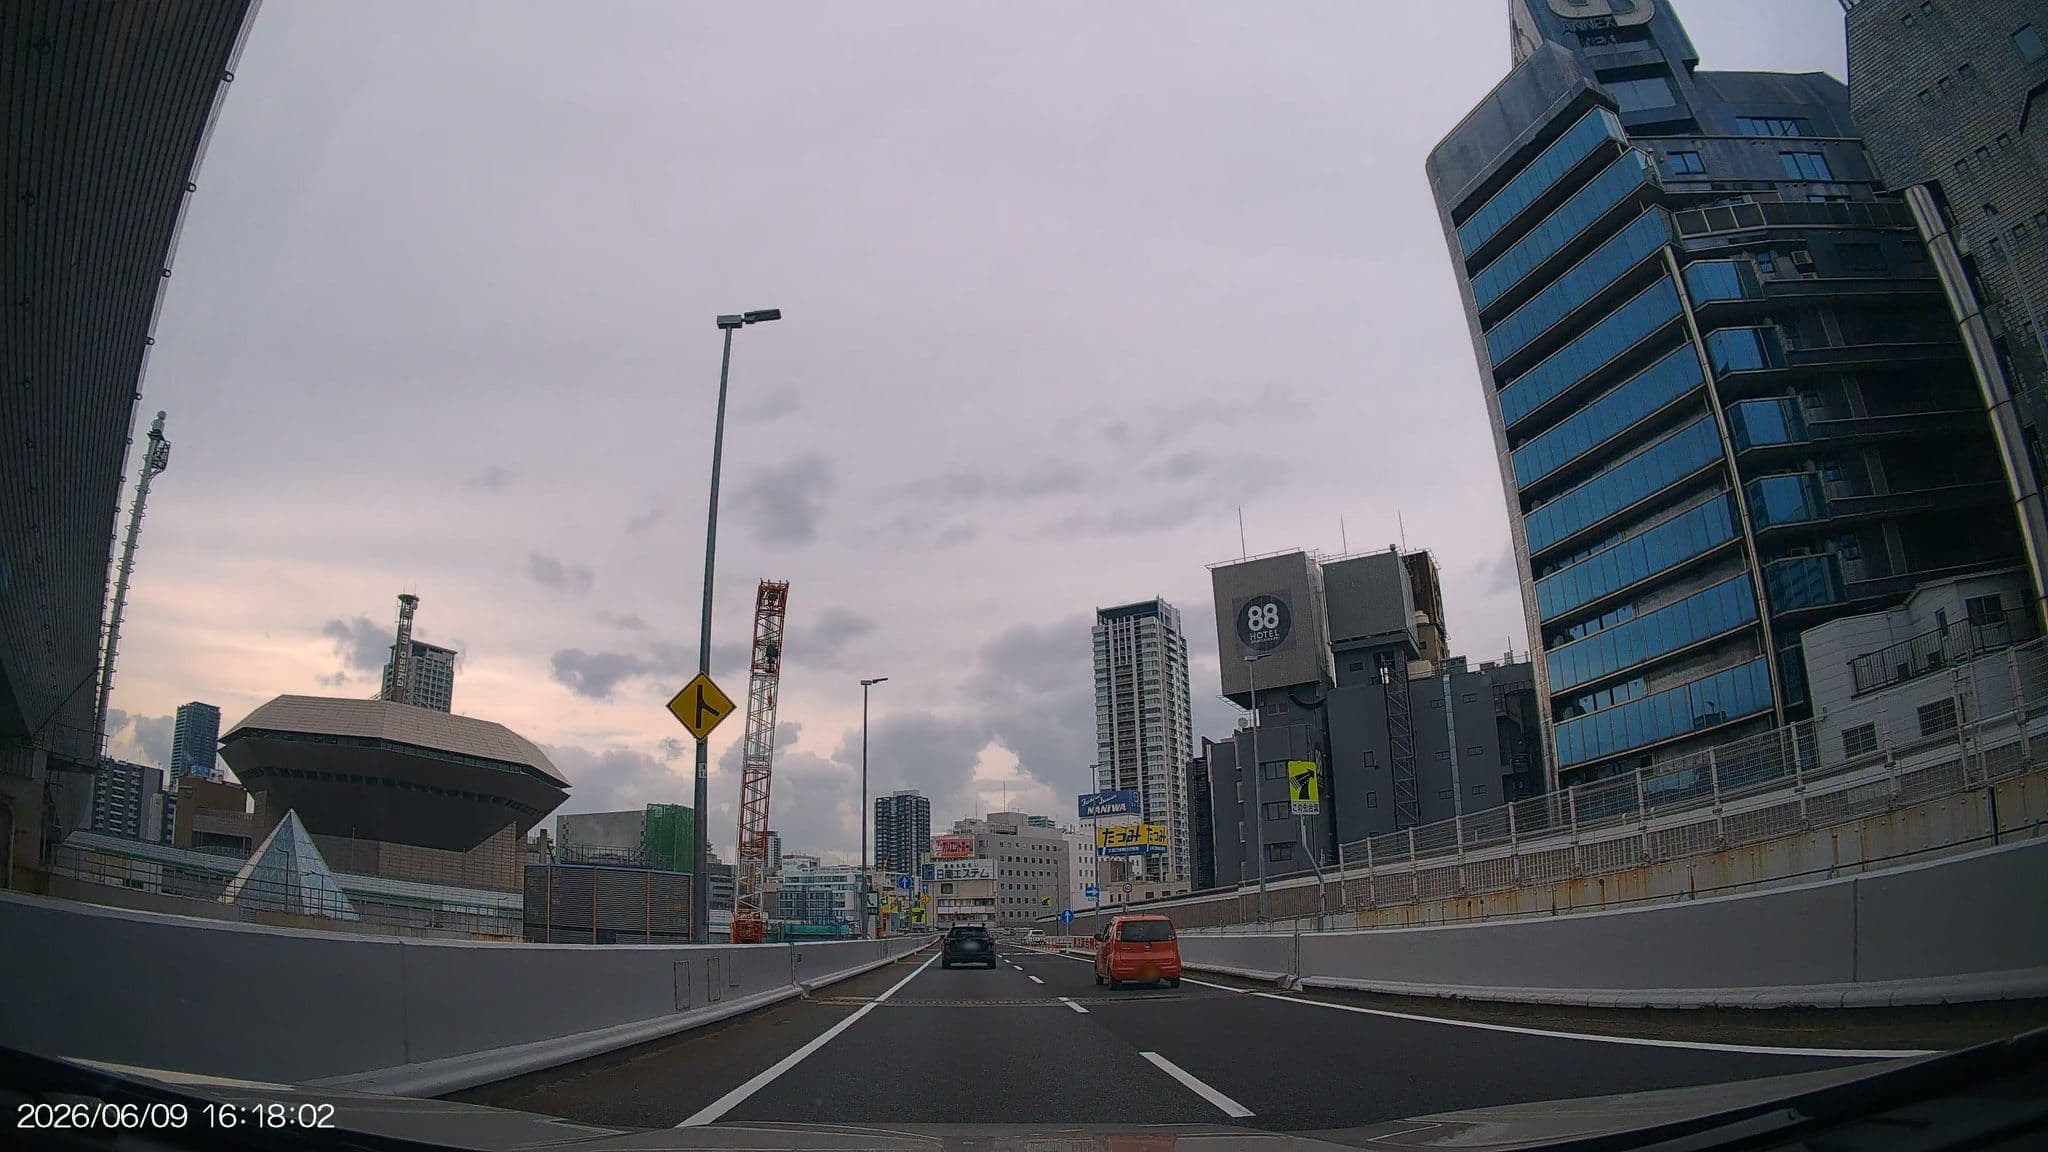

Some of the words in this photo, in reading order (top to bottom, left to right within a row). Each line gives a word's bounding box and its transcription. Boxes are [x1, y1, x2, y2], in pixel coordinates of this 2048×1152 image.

[1248, 603, 1279, 631] 88
[1250, 629, 1280, 640] HOTEL
[1087, 803, 1127, 815] NANIWA
[1102, 825, 1141, 849] たつみ
